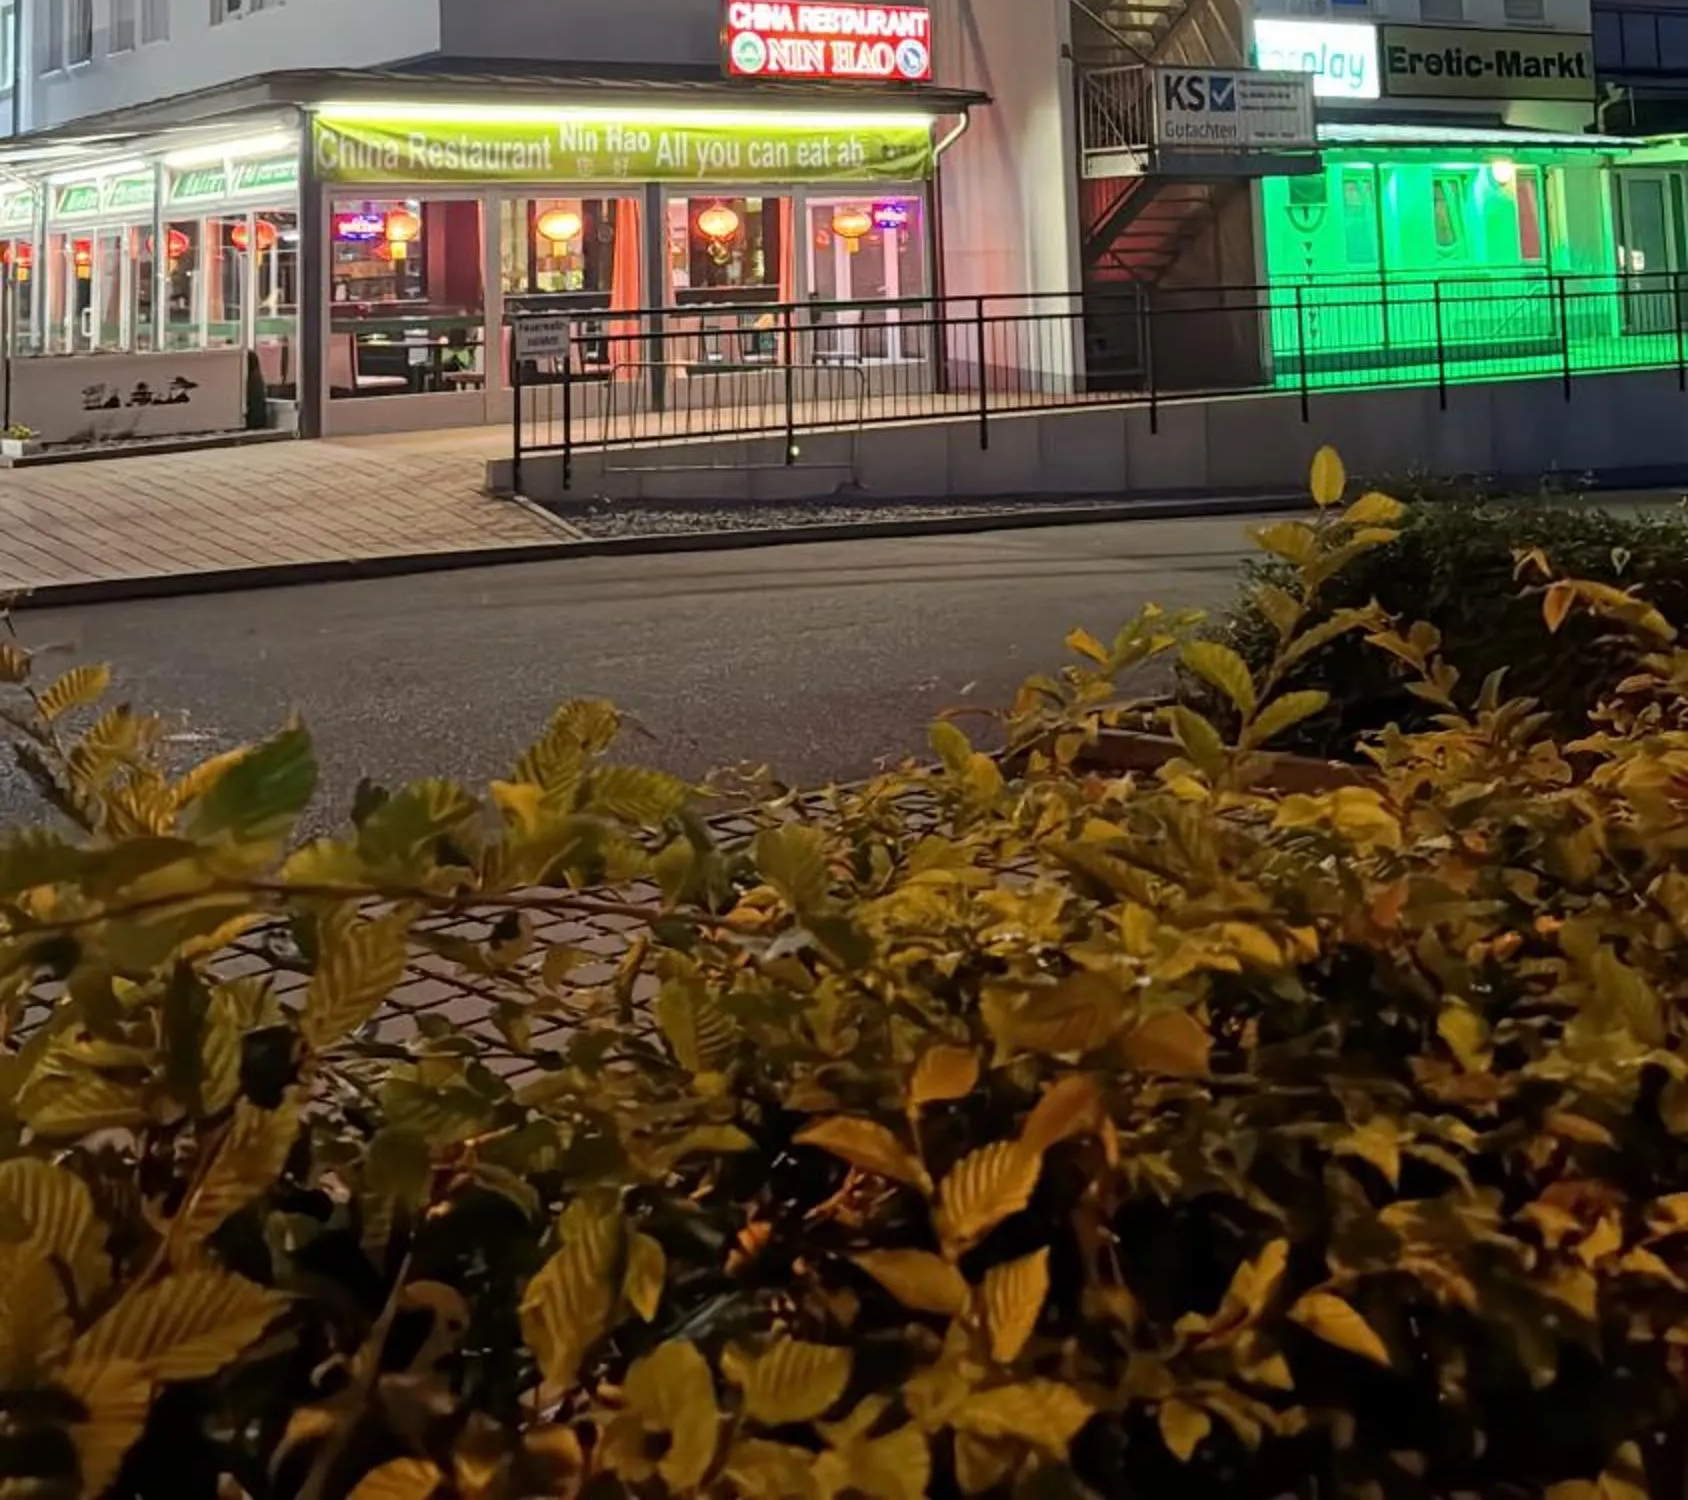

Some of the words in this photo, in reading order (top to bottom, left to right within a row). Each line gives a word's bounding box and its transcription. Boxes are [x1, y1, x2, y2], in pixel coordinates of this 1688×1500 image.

[728, 1, 794, 32] CHINA
[798, 6, 930, 37] RESTAURANT
[766, 37, 825, 73] NIN
[830, 41, 896, 76] HAO
[1386, 44, 1586, 80] Erotic-Markt
[1164, 73, 1206, 112] KS
[1165, 120, 1237, 140] Gutachten
[316, 129, 400, 170] China
[407, 131, 552, 171] Restaurant
[559, 120, 598, 153] Nin
[605, 122, 651, 153] Hao
[655, 131, 689, 168] All
[695, 141, 741, 179] you
[747, 143, 794, 169] can
[796, 137, 832, 168] eat
